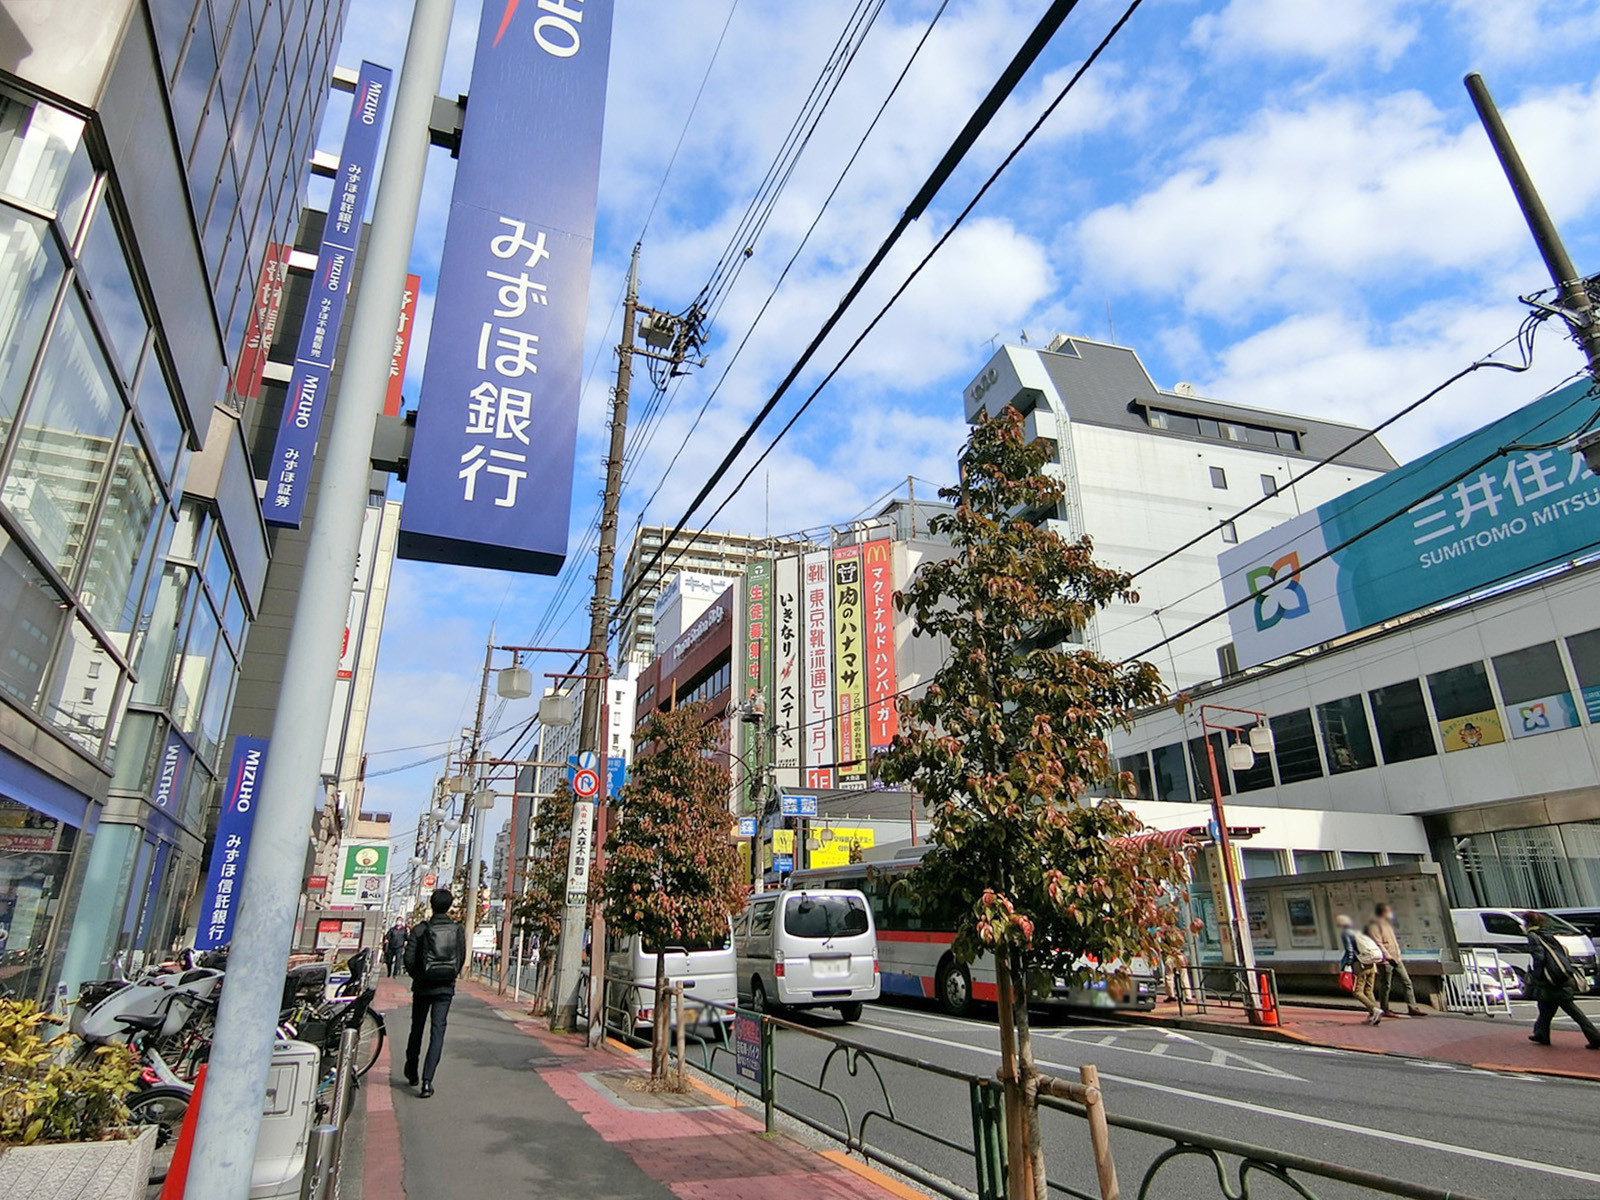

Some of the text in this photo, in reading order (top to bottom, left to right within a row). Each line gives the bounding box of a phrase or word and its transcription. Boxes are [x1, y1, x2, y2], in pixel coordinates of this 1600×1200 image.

[362, 80, 383, 125] MIZUHO
[336, 163, 362, 234] みずほ信託銀行
[328, 253, 346, 291] MIZUHO
[295, 374, 319, 428] MIZUHO
[459, 215, 551, 508] みずほ銀行
[274, 448, 300, 508] みずほ証券
[1418, 487, 1600, 569] SUMITOMO MITSU
[749, 585, 763, 679] 生徒募集中
[838, 587, 859, 688] 肉のハナマサ
[871, 567, 891, 737] マクドナルドハンバーガー
[810, 589, 827, 763] 東京靴流通センター
[237, 749, 261, 813] MIZUHO
[208, 834, 241, 941] みずほ信託銀行
